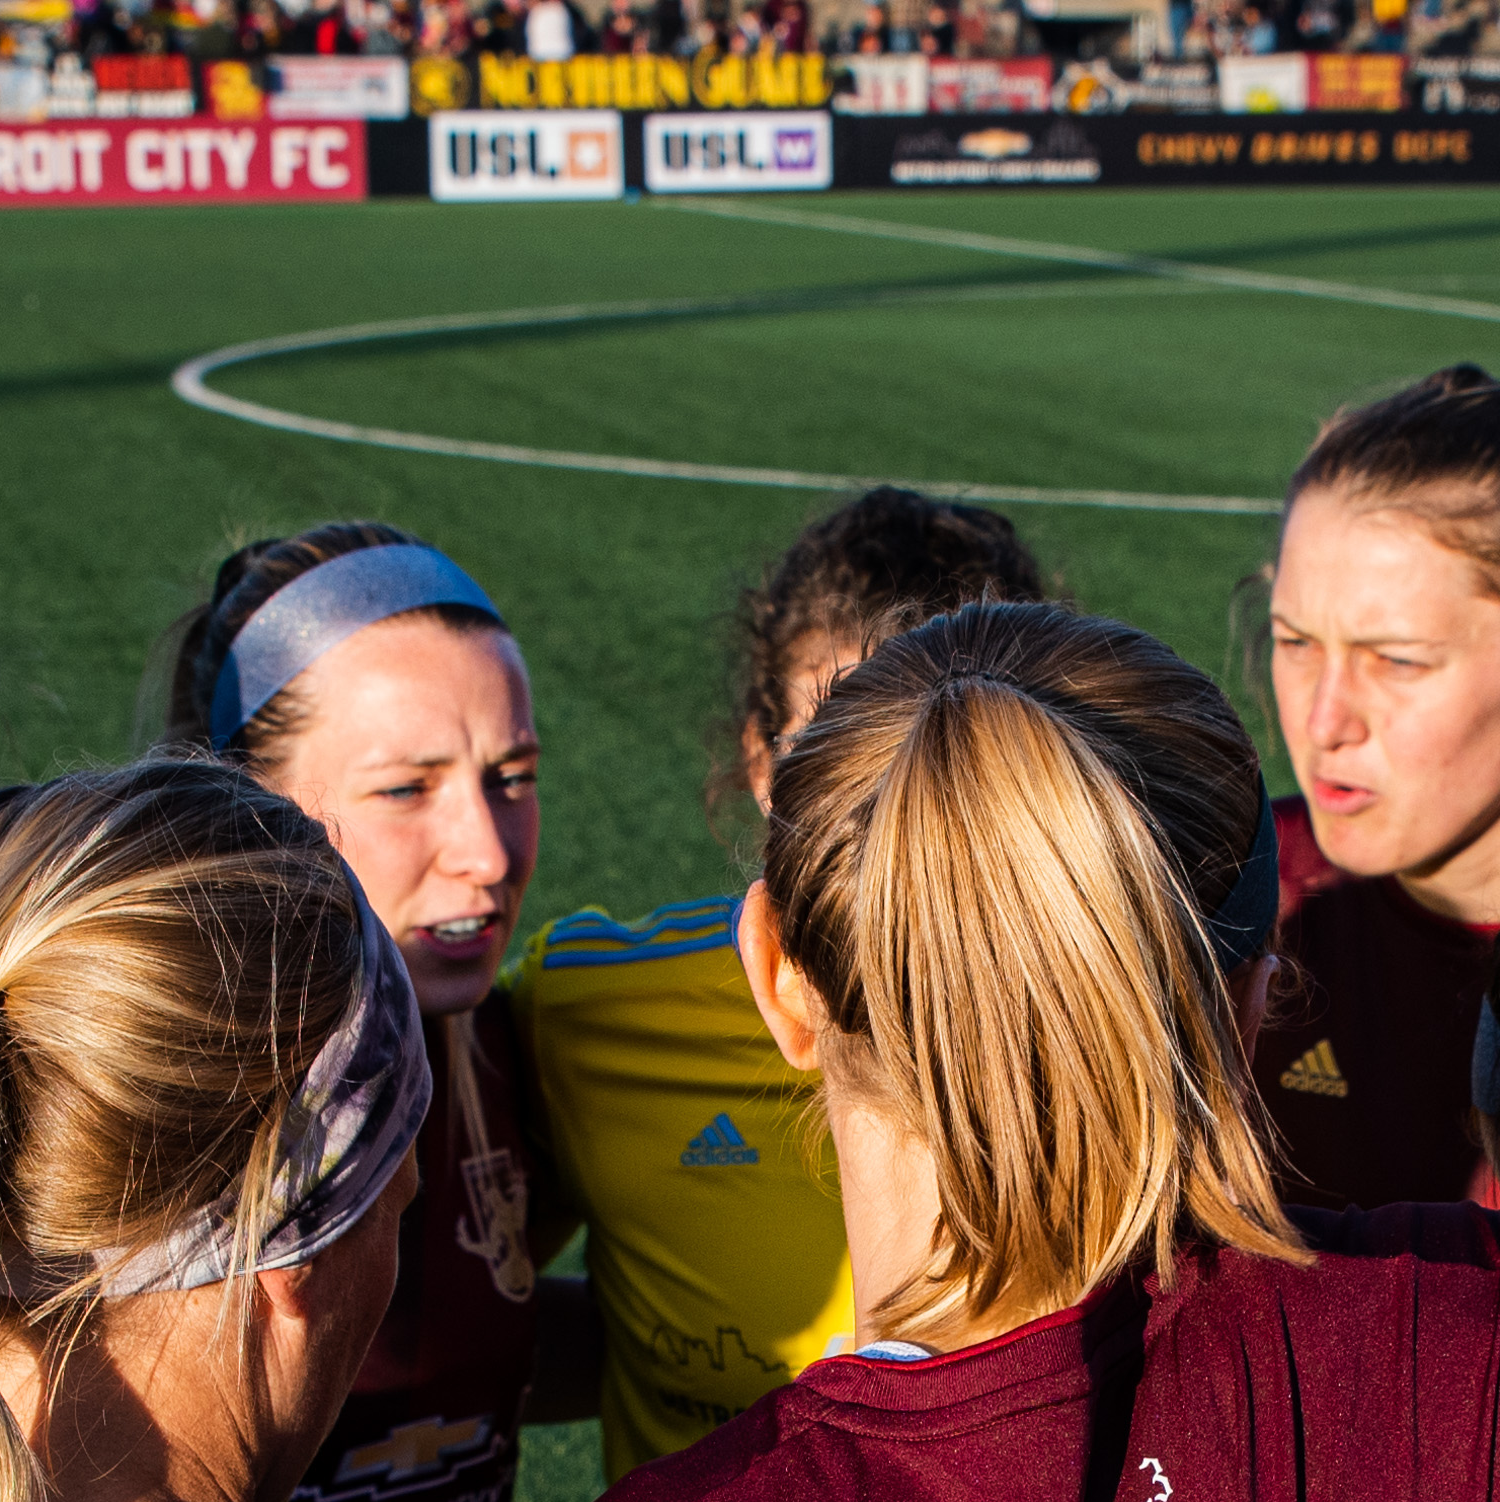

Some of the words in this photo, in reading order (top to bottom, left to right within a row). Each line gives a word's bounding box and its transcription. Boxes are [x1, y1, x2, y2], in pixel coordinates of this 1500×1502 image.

[125, 128, 257, 191] CITY
[270, 126, 350, 189] FC
[448, 131, 558, 179] USL
[661, 130, 766, 171] USL
[1138, 132, 1242, 164] CHEVY
[680, 1144, 759, 1166] adidas
